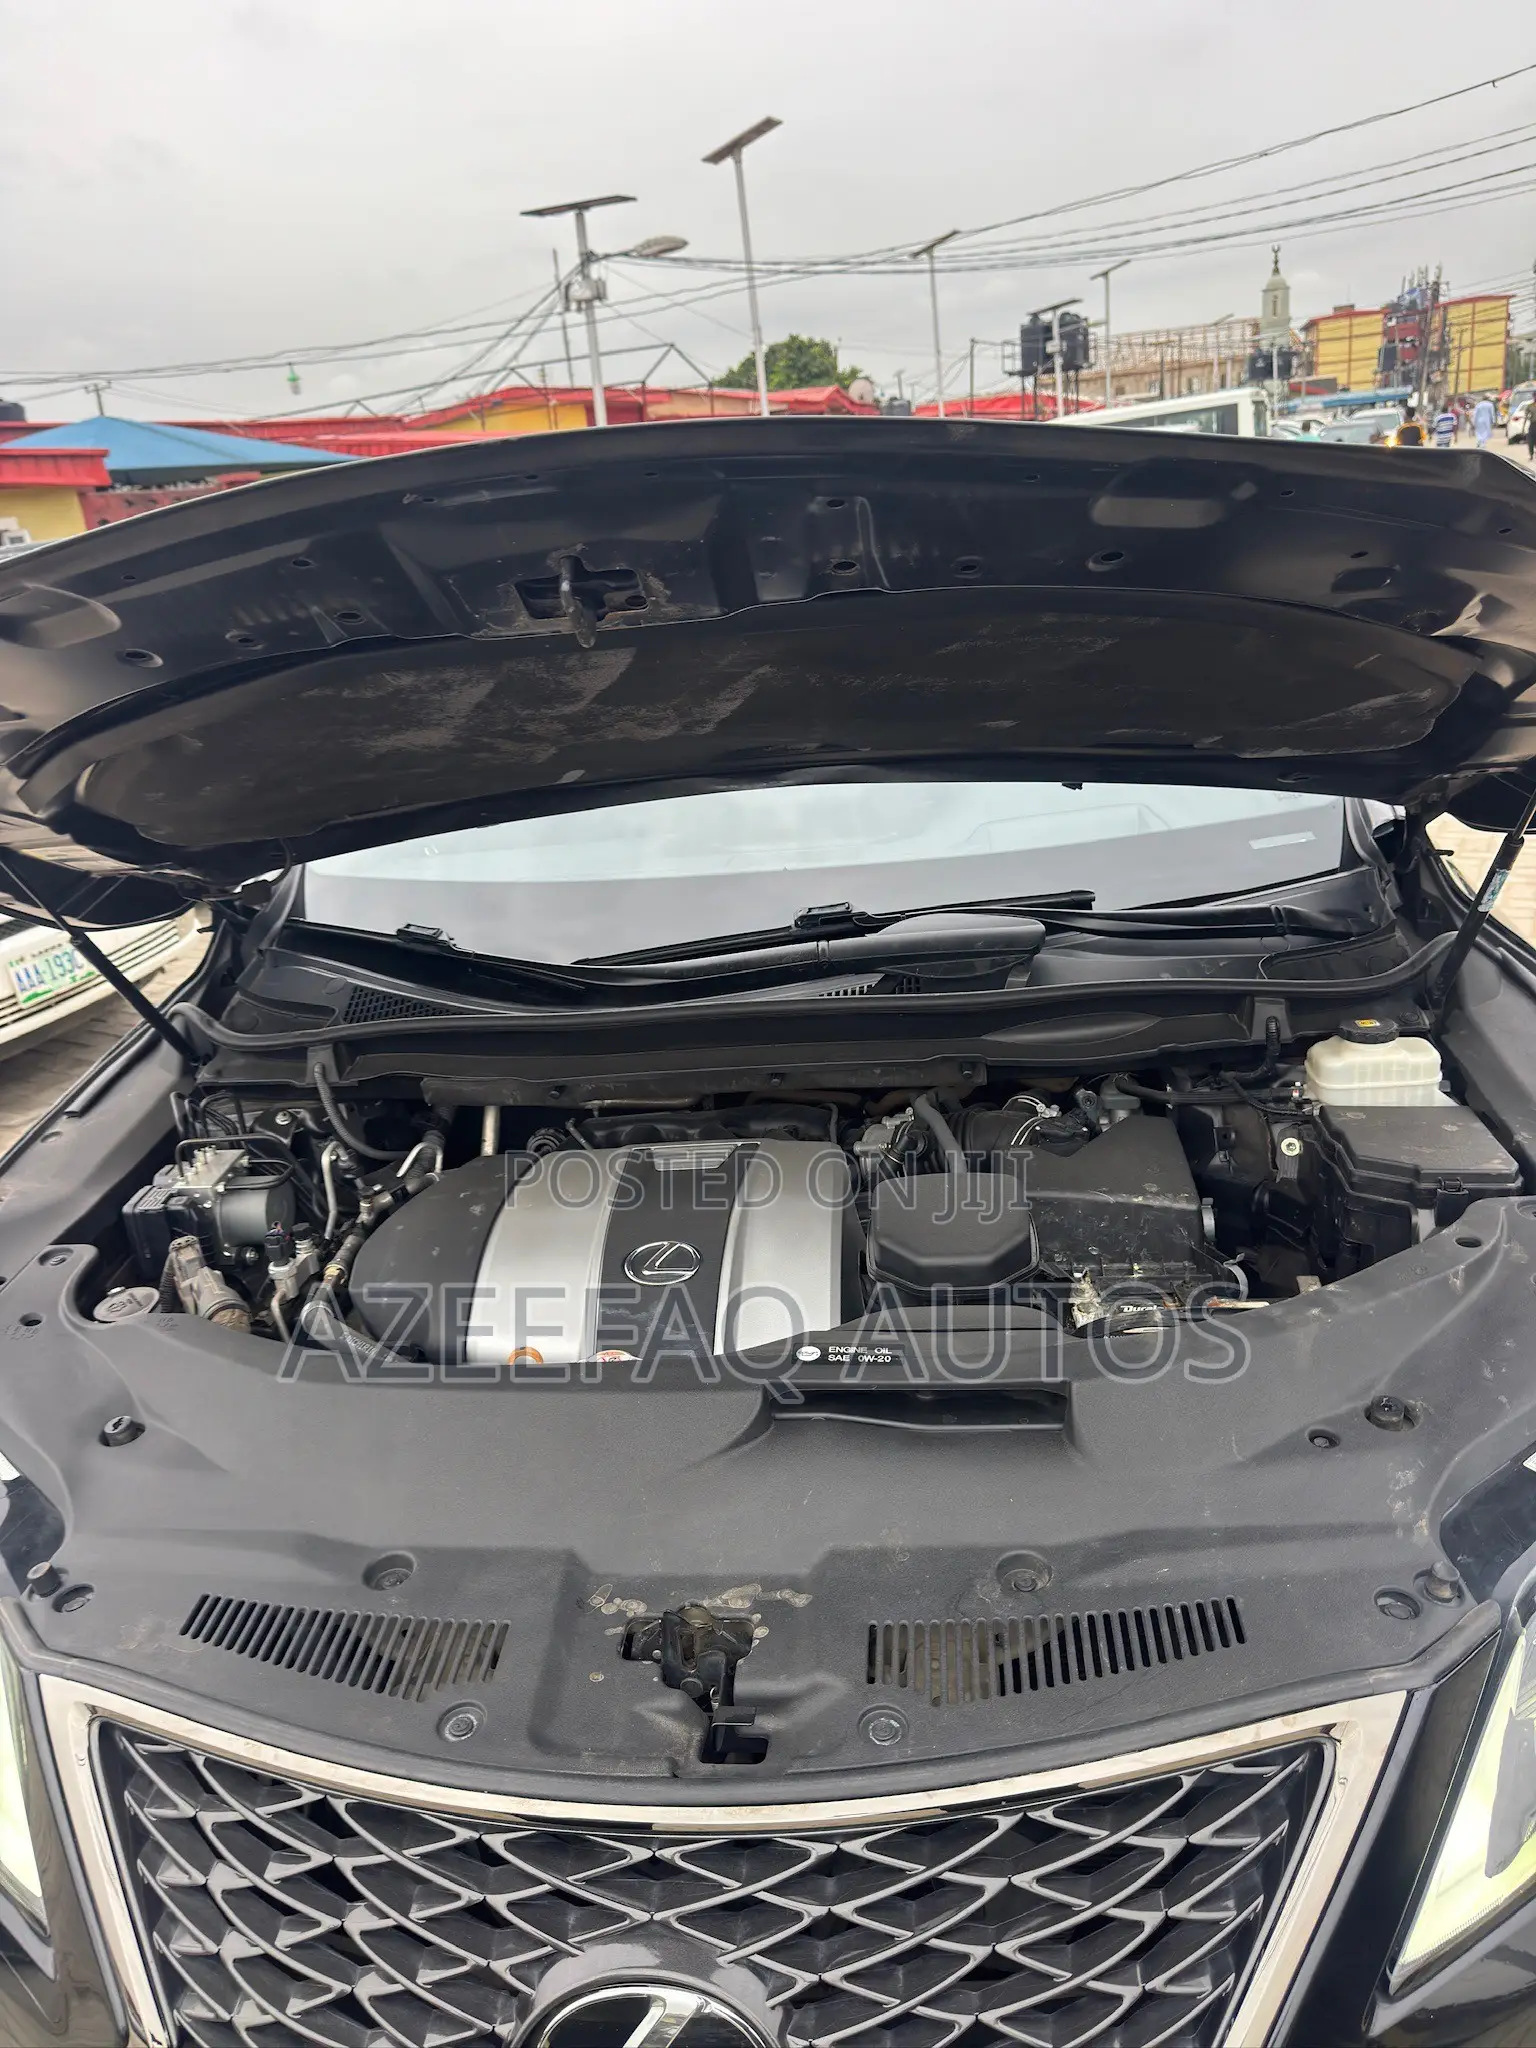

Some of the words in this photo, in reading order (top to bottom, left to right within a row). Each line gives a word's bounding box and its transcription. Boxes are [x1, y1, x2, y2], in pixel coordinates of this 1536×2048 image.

[828, 1345, 868, 1354] ENGINE
[874, 1346, 893, 1355] OIL
[827, 1354, 851, 1362] SAE
[857, 1355, 892, 1363] 0W-20
